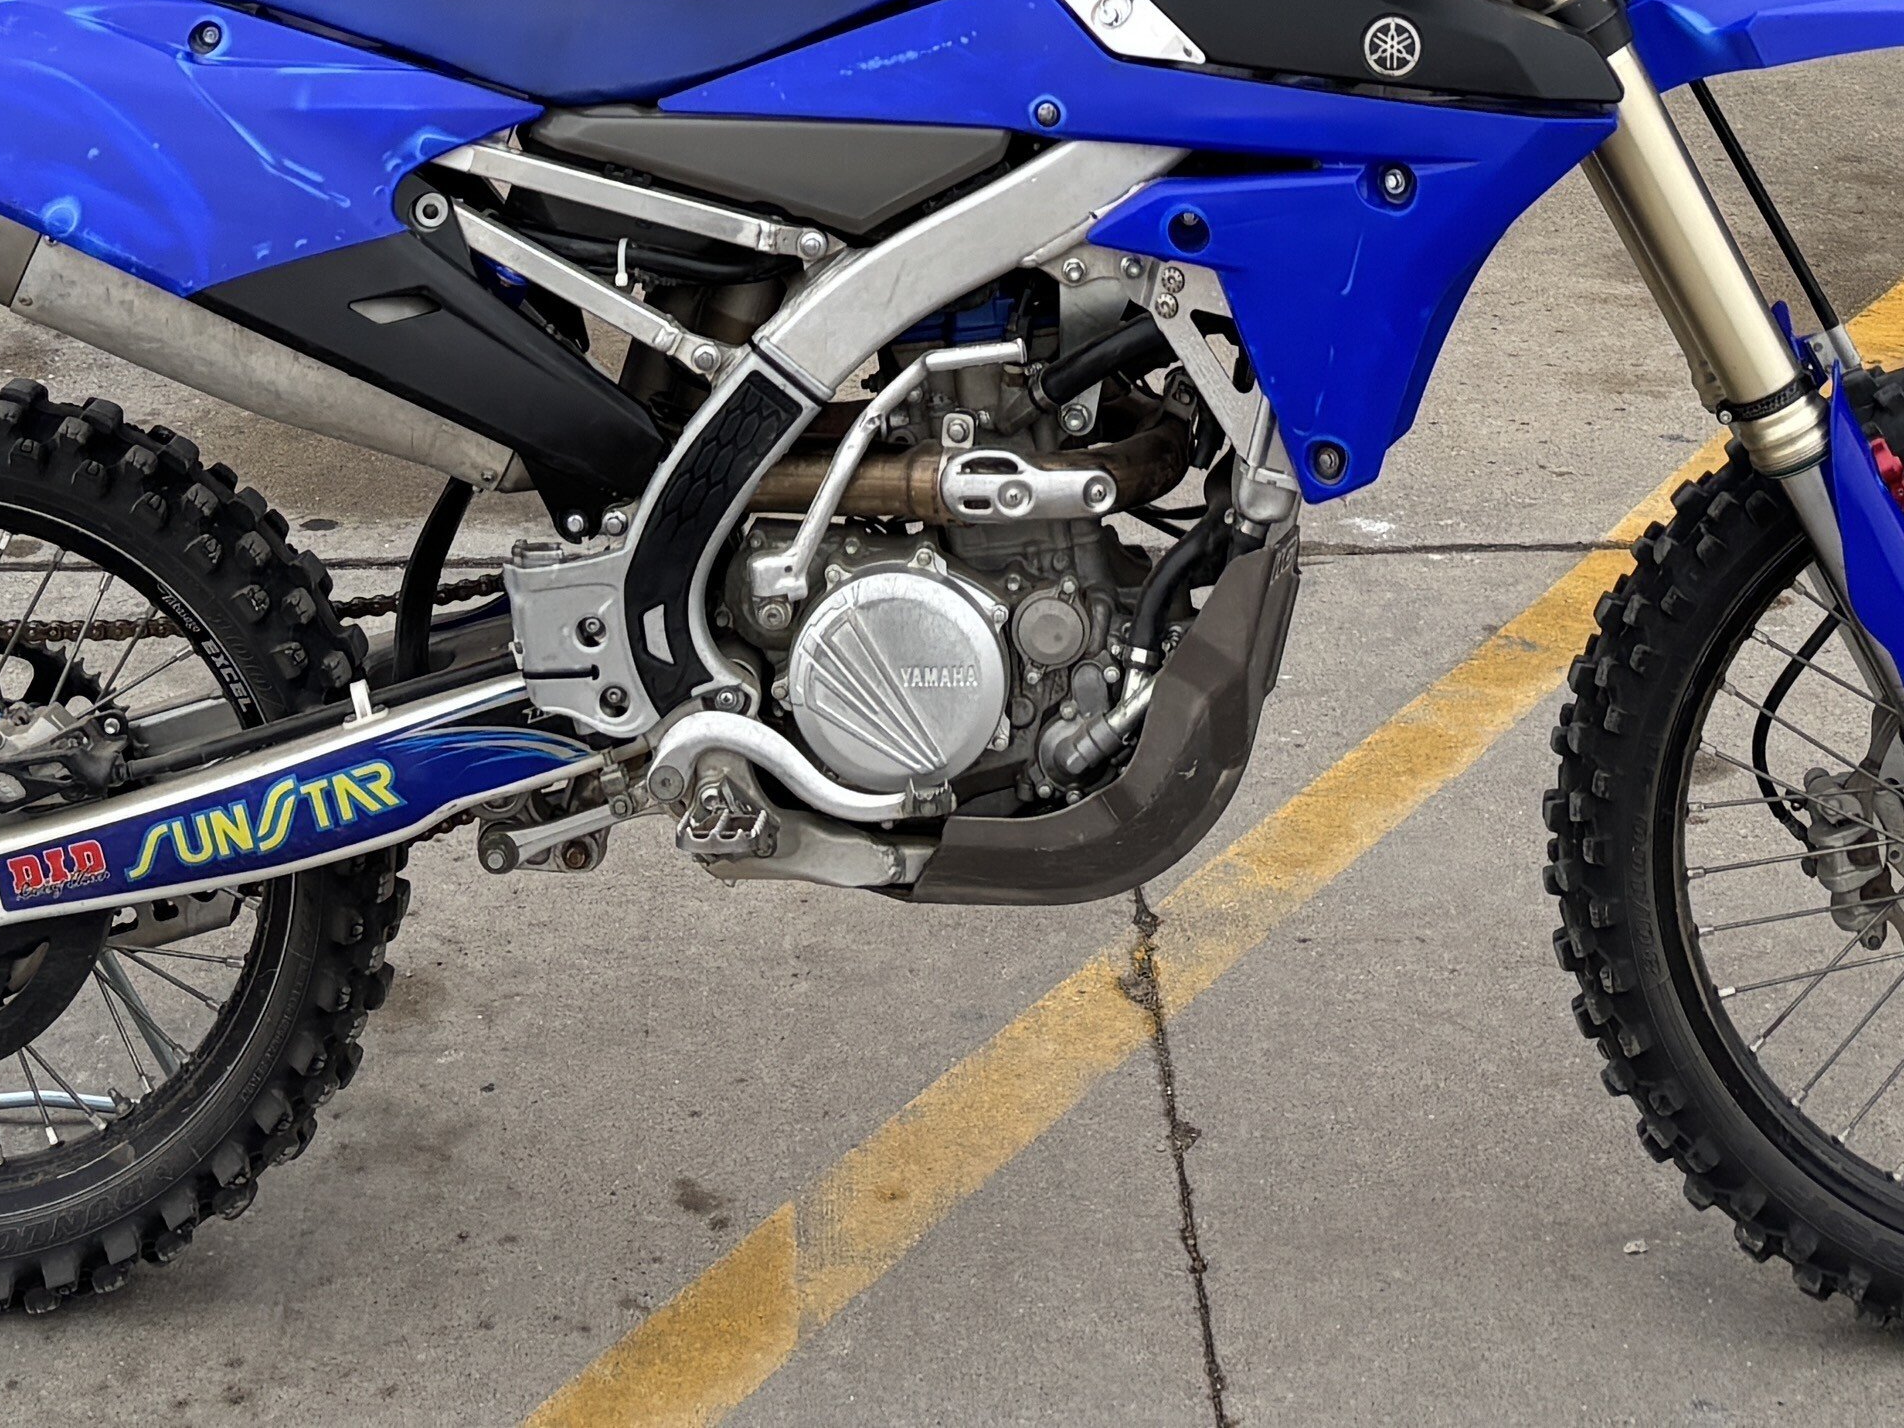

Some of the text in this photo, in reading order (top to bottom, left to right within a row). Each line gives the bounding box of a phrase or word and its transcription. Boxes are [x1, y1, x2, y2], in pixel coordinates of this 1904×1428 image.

[201, 639, 252, 713] EXCEL
[899, 665, 978, 687] YAMAHA
[127, 761, 404, 881] SUNSTAR
